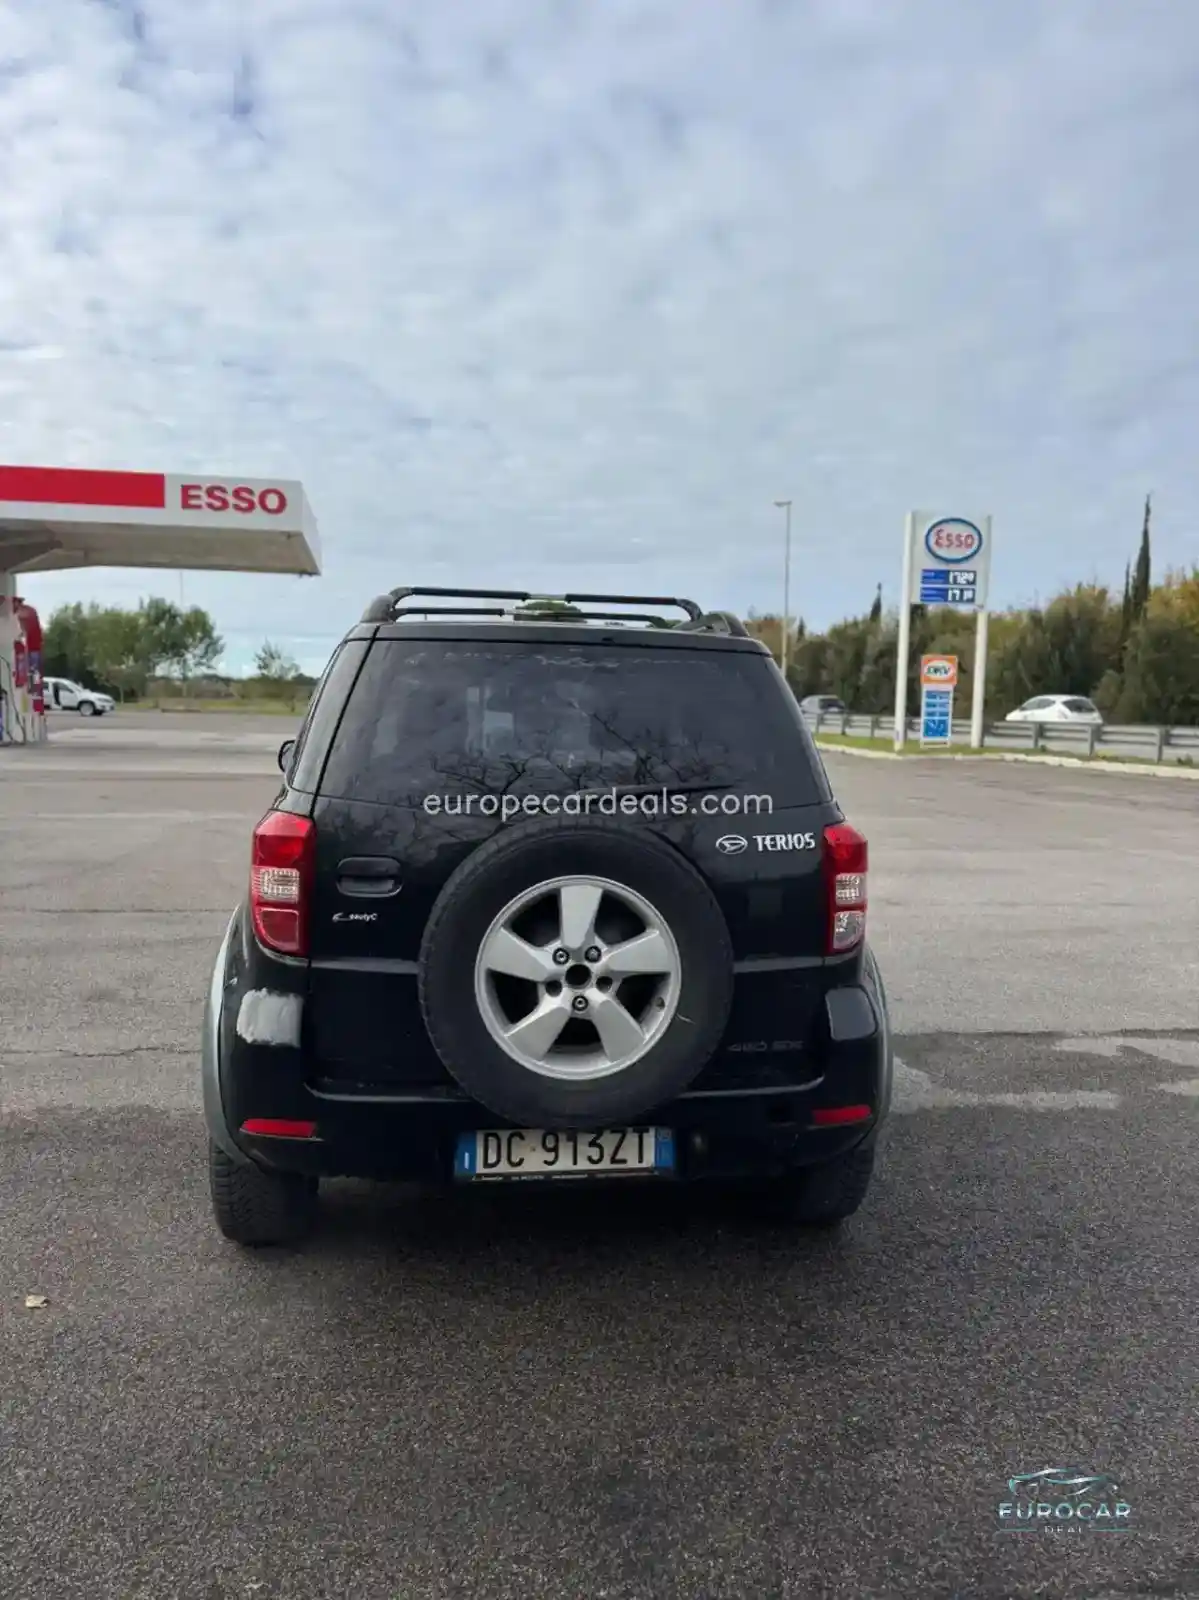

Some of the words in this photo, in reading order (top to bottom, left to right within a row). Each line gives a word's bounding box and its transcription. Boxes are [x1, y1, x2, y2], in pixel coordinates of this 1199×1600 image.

[181, 484, 288, 515] ESSO
[752, 832, 816, 852] TERIOS
[482, 1131, 526, 1169] DC
[541, 1127, 651, 1167] 913ZT
